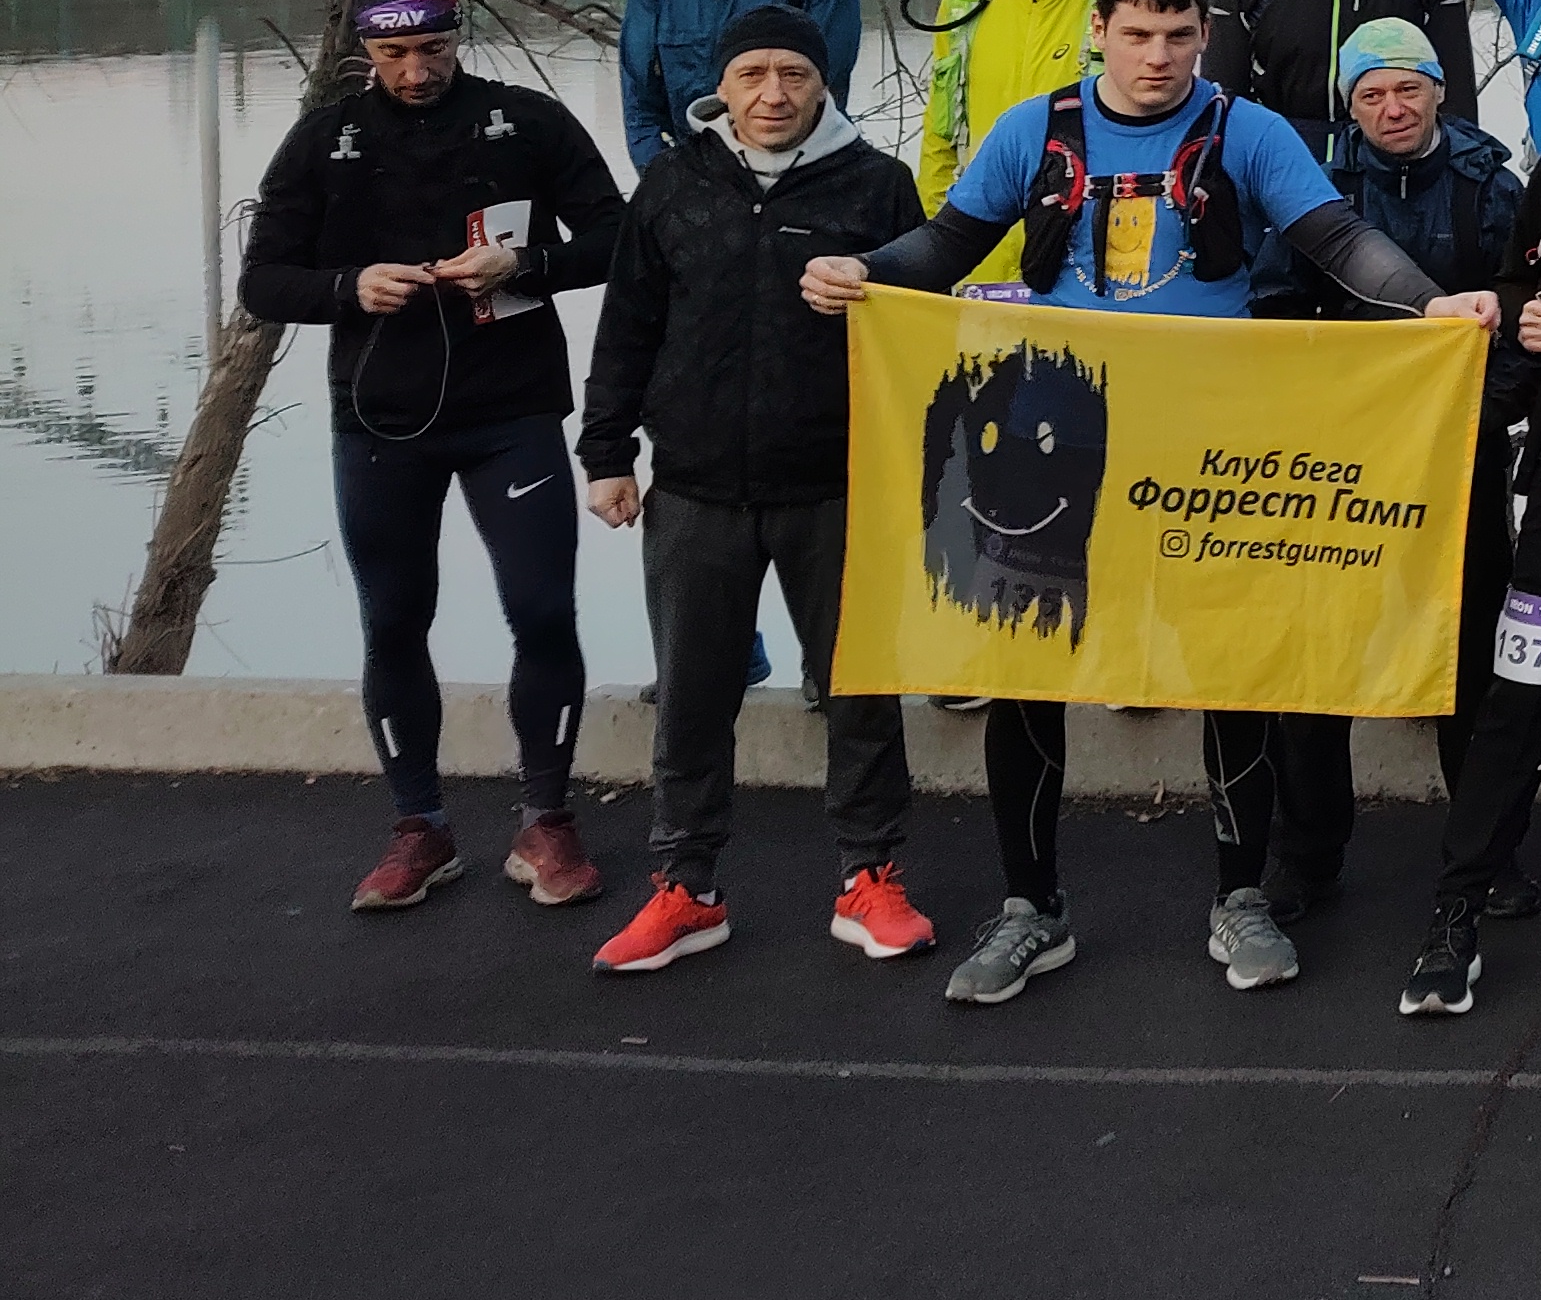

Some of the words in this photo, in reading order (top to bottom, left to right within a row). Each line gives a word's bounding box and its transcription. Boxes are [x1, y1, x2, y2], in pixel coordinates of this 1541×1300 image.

[1200, 448, 1283, 485] Клуб
[1289, 452, 1363, 485] бега
[1127, 476, 1317, 523] Форрест
[1327, 487, 1428, 529] Гамп
[1193, 531, 1385, 571] forrestgumpvl
